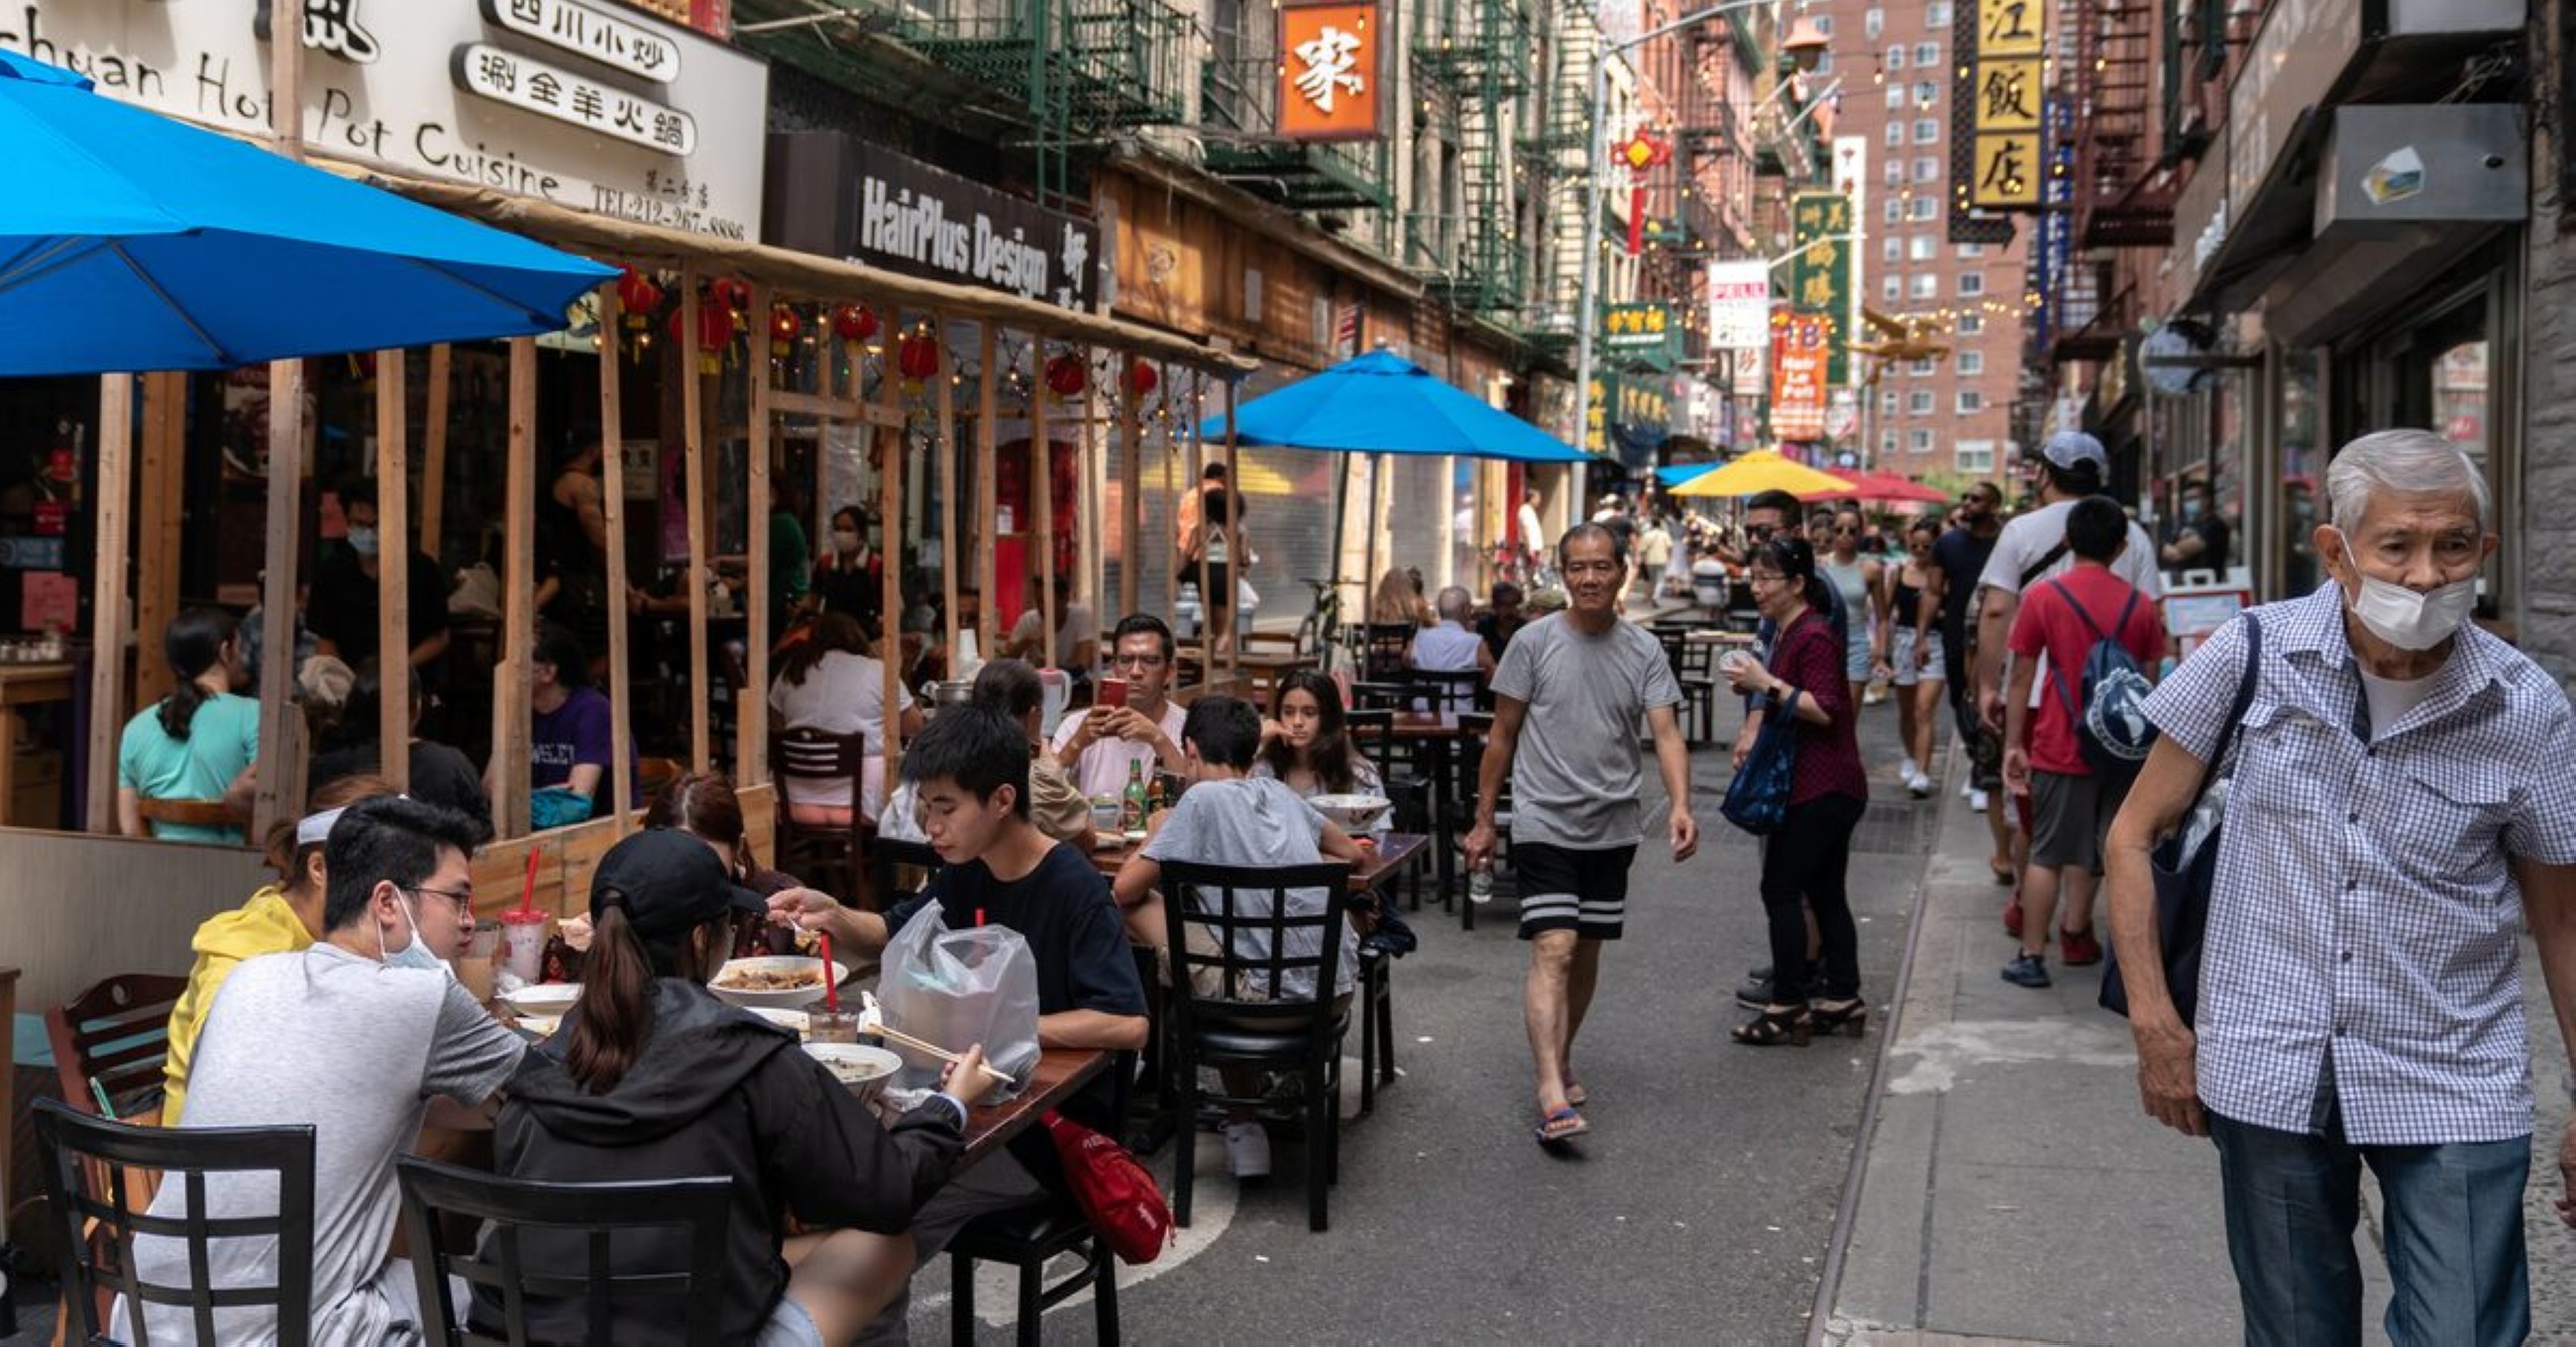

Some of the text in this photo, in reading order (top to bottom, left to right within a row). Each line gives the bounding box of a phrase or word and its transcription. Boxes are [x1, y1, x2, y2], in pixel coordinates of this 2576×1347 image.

[510, 0, 665, 69] 四川小炒
[1294, 26, 1364, 113] 家
[317, 87, 392, 156] Pot
[415, 122, 560, 199] Cuisine
[480, 52, 685, 149] 涮全羊火鍋
[1981, 0, 2037, 196] 江飯店
[861, 175, 1047, 301] HairPlus Design
